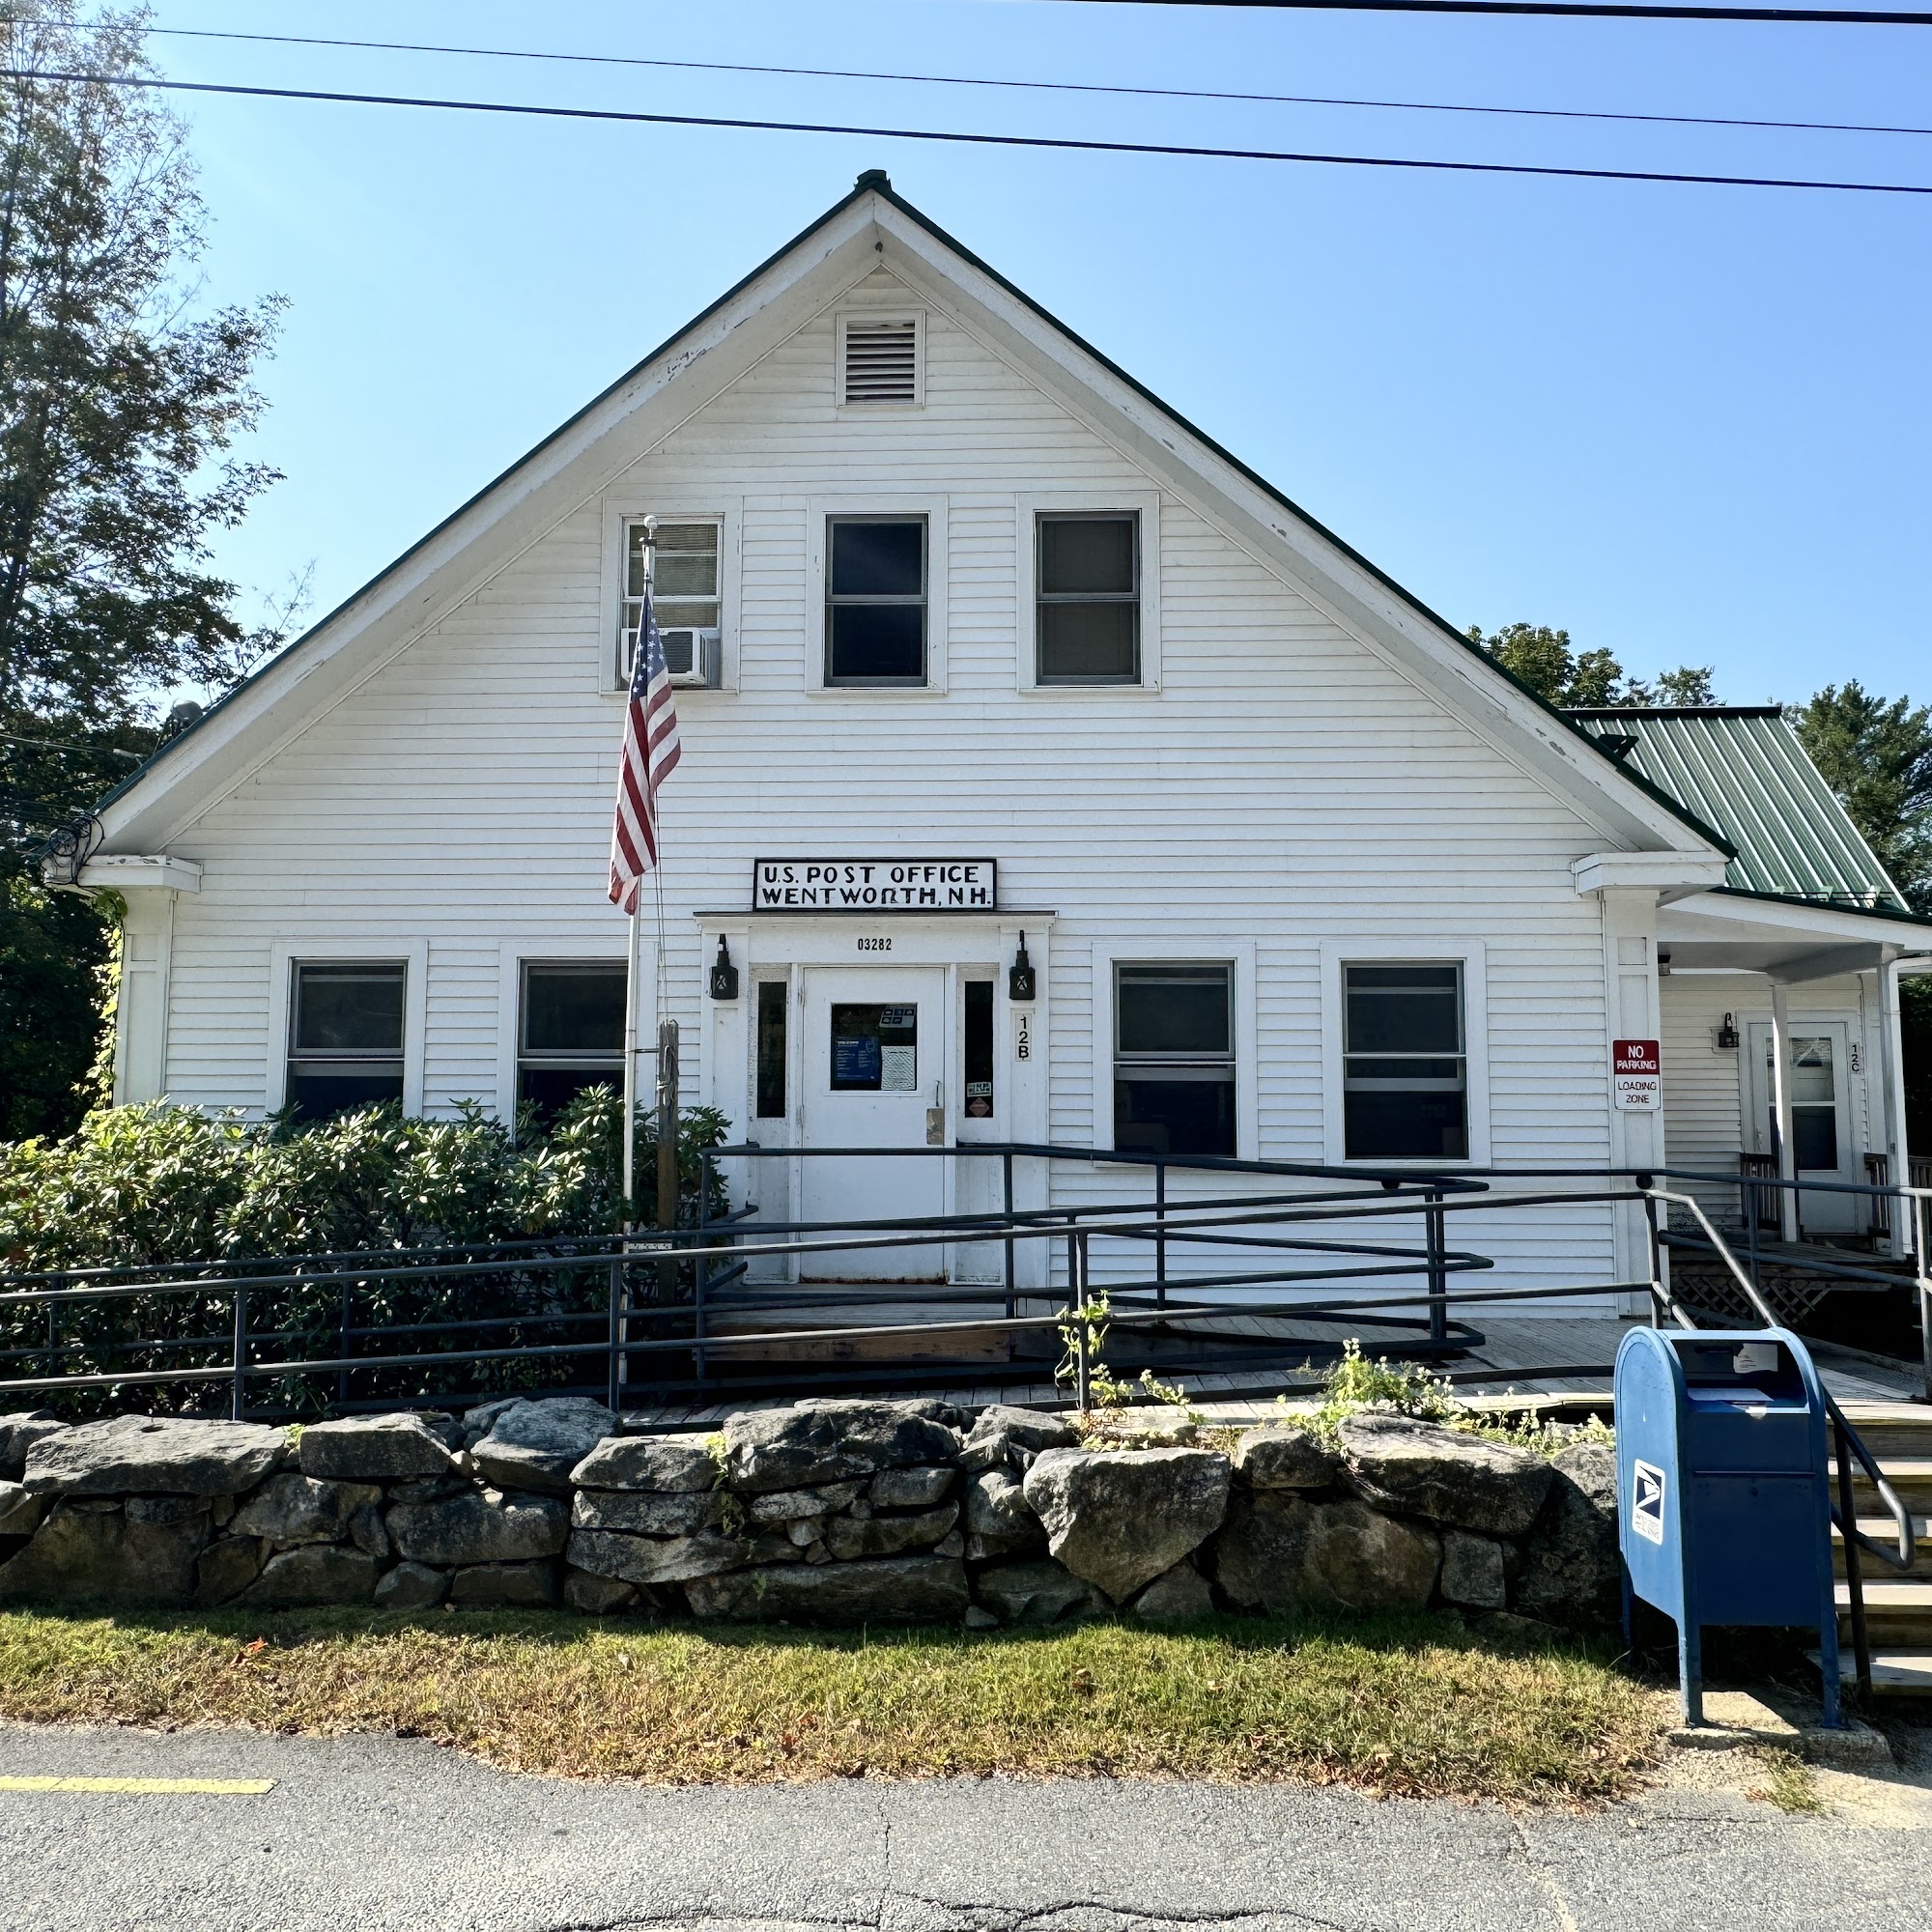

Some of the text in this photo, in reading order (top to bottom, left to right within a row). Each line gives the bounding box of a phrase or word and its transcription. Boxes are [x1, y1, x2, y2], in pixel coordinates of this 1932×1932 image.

[764, 866, 979, 884] U.S. POST OFFICE
[762, 888, 942, 907] WENTWORTH,
[858, 938, 892, 951] 03282
[1628, 1045, 1644, 1059] NO
[1616, 1060, 1657, 1069] PARKING
[1618, 1081, 1657, 1091] LOADING
[1626, 1094, 1649, 1103] ZONE
